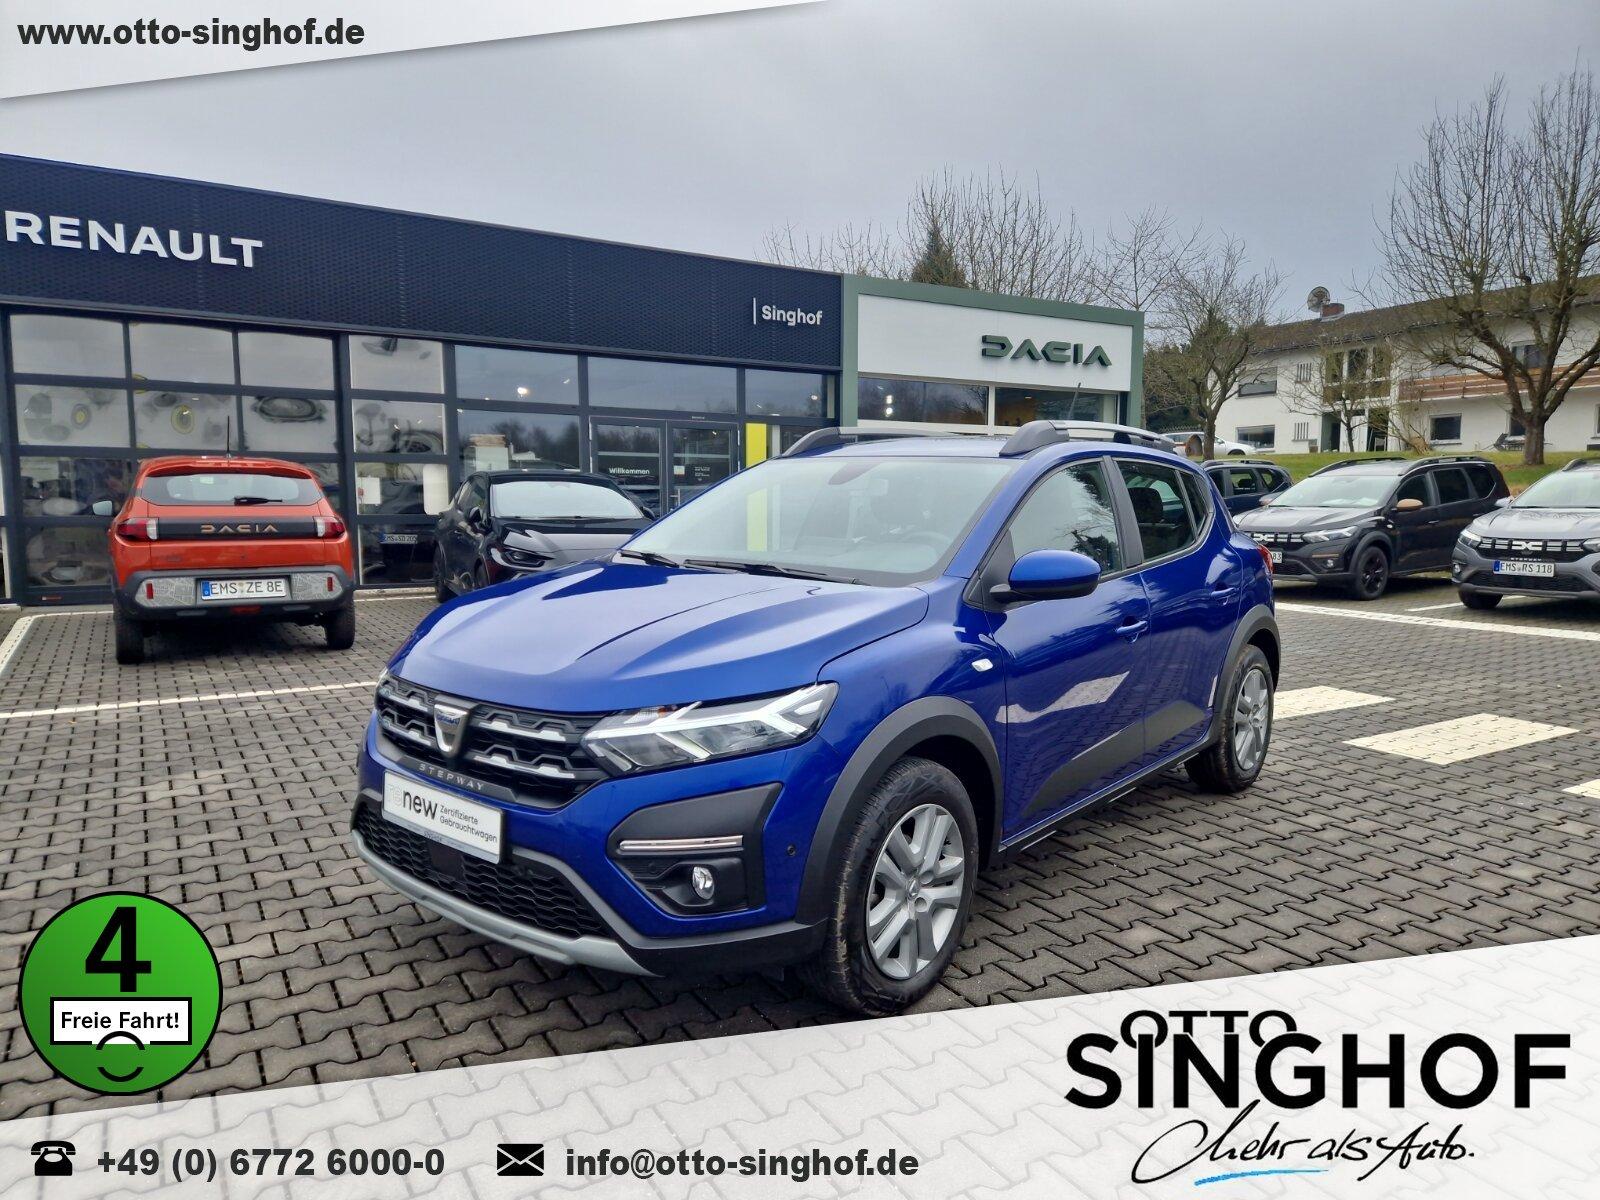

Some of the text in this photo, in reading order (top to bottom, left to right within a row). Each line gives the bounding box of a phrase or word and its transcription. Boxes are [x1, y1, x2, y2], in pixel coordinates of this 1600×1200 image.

[5, 210, 263, 268] RENAULT
[761, 304, 823, 327] Singhof
[981, 334, 1112, 367] DACIA
[608, 467, 650, 475] Willkommen
[200, 524, 279, 533] DACIA
[1500, 562, 1553, 573] EMS RS 118
[210, 581, 283, 595] EMS ZE 8E
[420, 763, 484, 790] STEPWAY
[440, 805, 479, 825] Zertifizierte
[440, 815, 498, 843] Gebrauchtwagen
